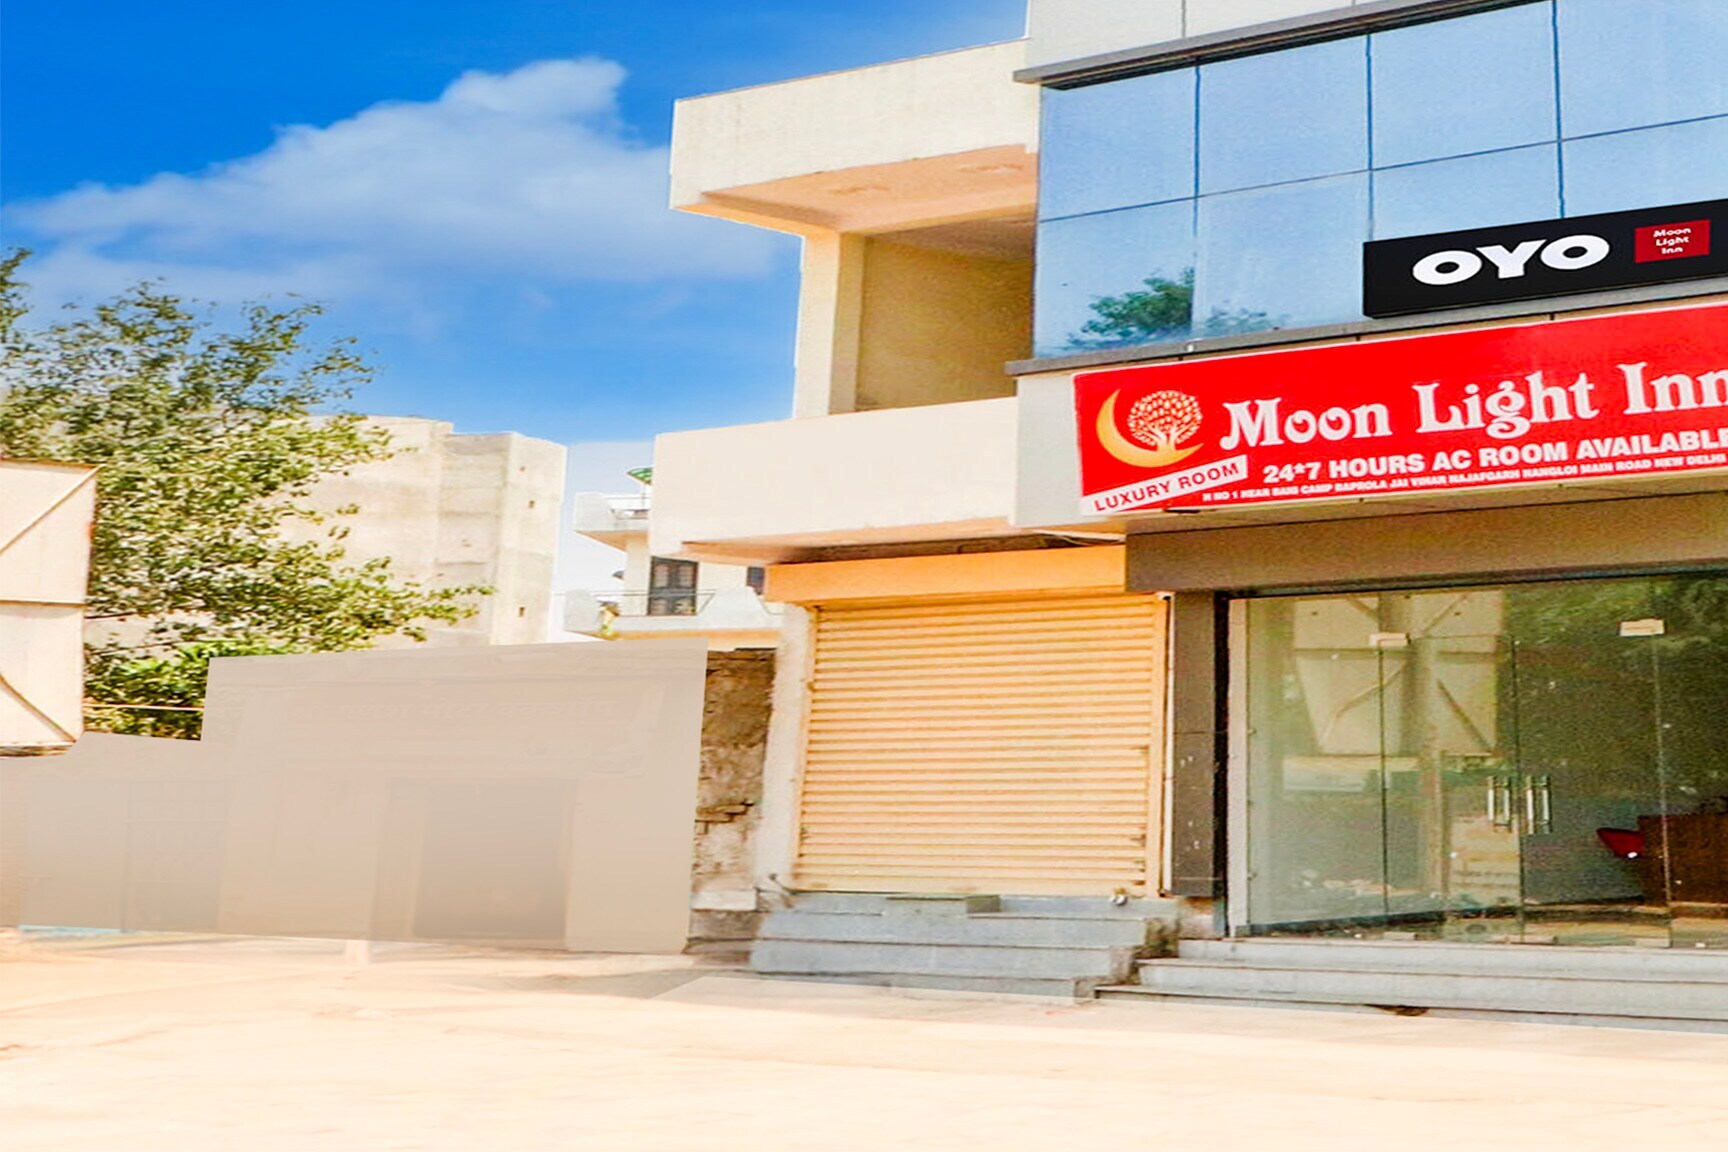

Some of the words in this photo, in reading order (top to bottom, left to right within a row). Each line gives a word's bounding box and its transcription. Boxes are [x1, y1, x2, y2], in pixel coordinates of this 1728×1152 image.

[1653, 228, 1691, 238] Moon
[1655, 236, 1690, 247] Light
[1661, 247, 1684, 255] Inn
[1412, 234, 1610, 285] OYO
[1219, 397, 1393, 449] Moon
[1412, 370, 1600, 440] Light
[1232, 490, 1238, 499] 1
[1240, 488, 1270, 499] NEAR
[1300, 483, 1333, 494] CAMP
[1389, 478, 1409, 488] JAI
[1410, 475, 1446, 487] VIHAR
[1449, 469, 1520, 484] NAJAFGARH
[1522, 465, 1578, 478] NANGLOI
[1580, 462, 1613, 474] MAIN
[1616, 459, 1652, 471] ROAD
[1654, 456, 1684, 468] NEW
[1686, 453, 1727, 465] DELHI
[1329, 453, 1426, 479] HOURS
[1432, 449, 1473, 471] AC
[1479, 441, 1569, 468] ROOM
[1093, 480, 1172, 512] LUXURY
[1178, 462, 1240, 489] ROOM
